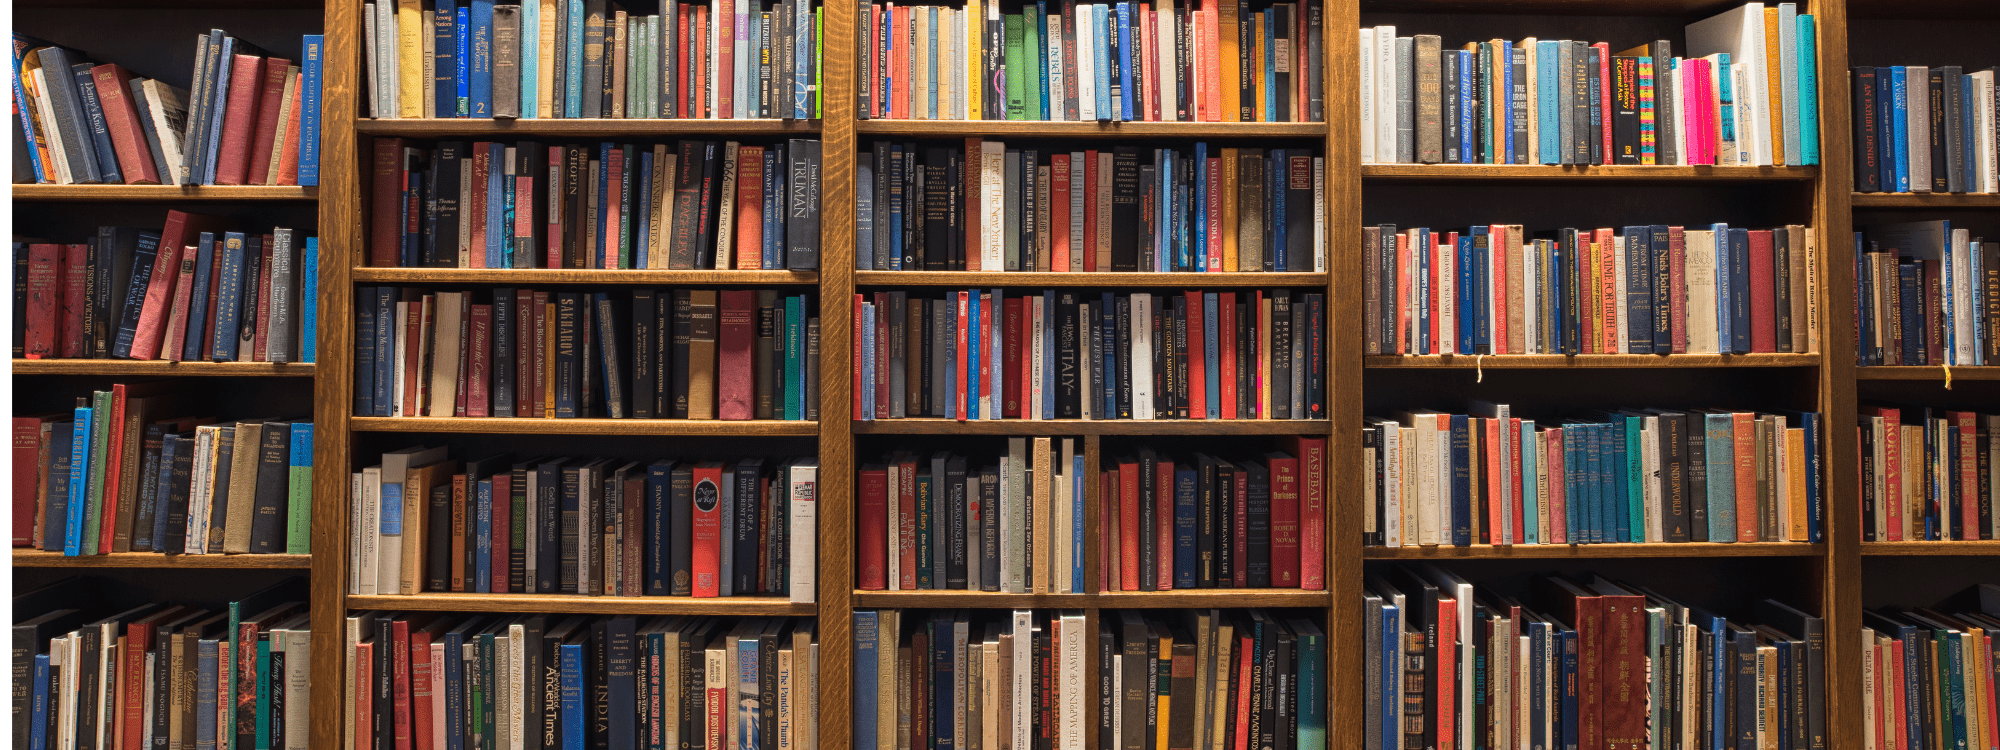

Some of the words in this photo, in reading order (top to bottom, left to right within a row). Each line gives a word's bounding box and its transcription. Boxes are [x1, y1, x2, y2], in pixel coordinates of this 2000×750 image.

[308, 44, 317, 60] LIFE
[424, 51, 432, 89] Hinduism
[1864, 84, 1871, 96] AN
[85, 82, 100, 112] Denny's
[93, 114, 104, 134] Knoll
[308, 116, 312, 125] IN
[477, 102, 484, 113] 2
[1865, 99, 1873, 131] EXHIBIT
[569, 149, 578, 195] CHOPIN
[723, 160, 734, 181] 1066
[992, 153, 1001, 174] Here
[793, 160, 805, 218] TRUMAN
[992, 177, 1001, 185] at
[701, 191, 709, 207] X-Ray
[992, 188, 1001, 204] The
[588, 206, 596, 237] Judaism
[677, 195, 690, 256] DIAGHILEV
[699, 209, 707, 234] Universe
[992, 208, 1001, 228] New
[273, 234, 282, 278] Sculpture
[282, 234, 290, 273] Classical
[718, 228, 727, 258] CONQUEST
[992, 230, 1001, 260] Yorker
[142, 264, 151, 281] THE
[1604, 260, 1612, 280] TIME
[1660, 250, 1668, 270] Niels
[134, 275, 141, 285] OF
[1605, 282, 1613, 300] FOR
[1660, 273, 1669, 301] Bohr's
[1988, 270, 1999, 314] VERDICT
[130, 287, 138, 305] WAR
[133, 284, 146, 320] POLITICS
[381, 294, 389, 306] The
[85, 303, 93, 335] VICTORY
[378, 308, 389, 335] Defining
[560, 299, 573, 356] SAKHAROV
[1606, 302, 1614, 328] TRUTH
[1660, 303, 1669, 332] Times,
[379, 336, 387, 362] Moment
[476, 322, 485, 352] William
[536, 357, 544, 387] Abraham
[1062, 348, 1074, 389] ITALY
[1887, 422, 1898, 479] KOREA
[1310, 447, 1319, 511] BASEBALL
[1670, 462, 1681, 516] UNDERWORLD
[920, 482, 928, 510] Bolivian
[1539, 474, 1547, 516] Buddhism
[918, 512, 927, 530] diary
[954, 483, 962, 538] DEMOCRATIZING
[986, 498, 994, 527] IMPERIAL
[907, 519, 915, 548] LINUS
[954, 539, 962, 565] FRANCE
[221, 648, 229, 668] Before
[1908, 633, 1916, 656] Henry
[219, 682, 228, 692] Big
[546, 667, 557, 712] Ancient
[1033, 686, 1039, 696] OF
[1070, 674, 1077, 684] OF
[218, 694, 228, 709] Bang
[273, 683, 282, 708] Hush!
[598, 684, 608, 732] INDIA
[781, 687, 789, 717] Panda's
[1103, 697, 1110, 705] TO
[1911, 684, 1920, 726] Commager
[546, 713, 557, 746] Times
